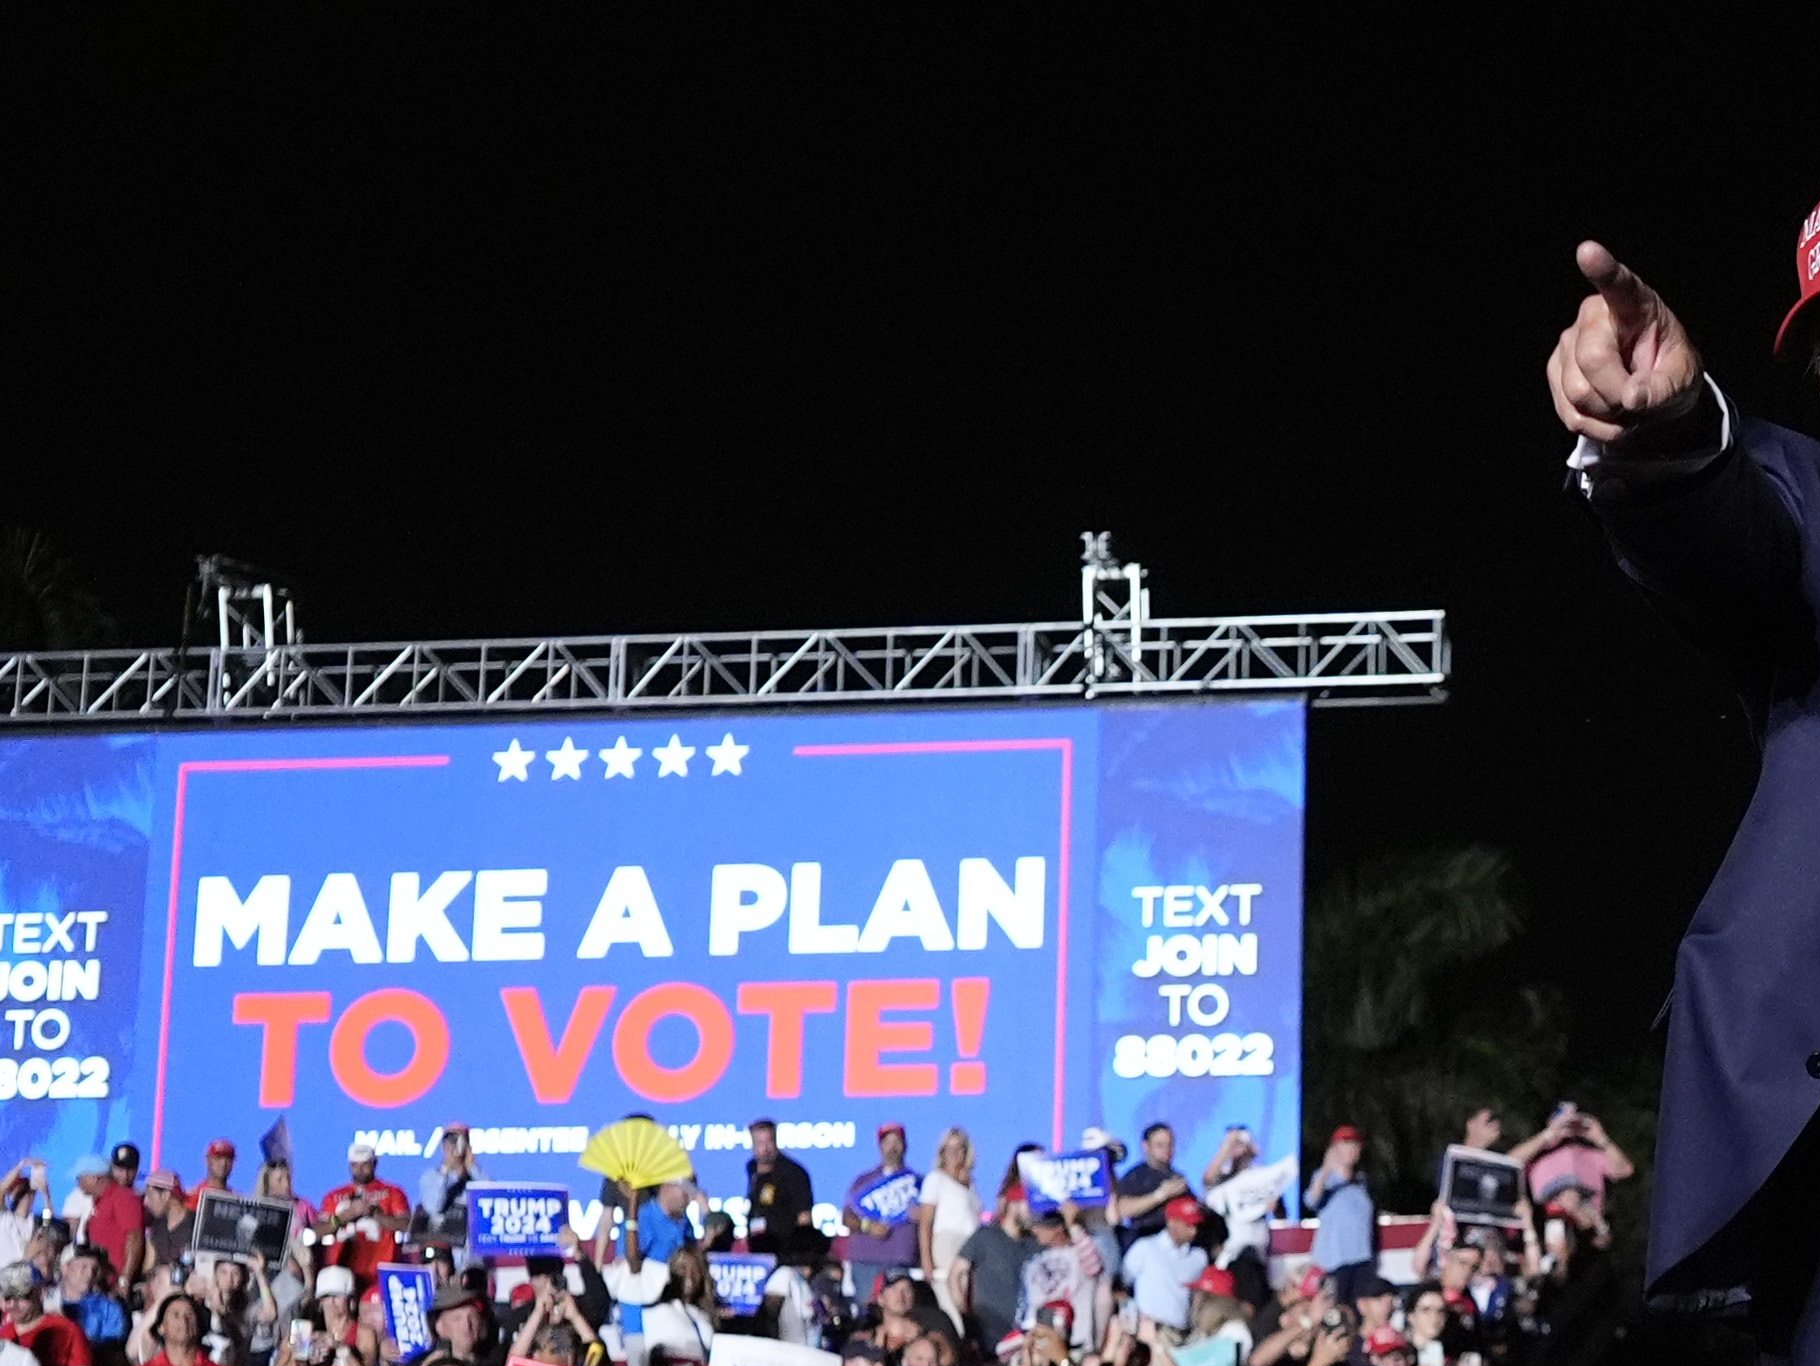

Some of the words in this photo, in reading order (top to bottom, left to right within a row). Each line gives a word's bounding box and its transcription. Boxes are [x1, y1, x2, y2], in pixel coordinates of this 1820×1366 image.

[193, 868, 548, 967] MAKE
[575, 866, 673, 959] A
[708, 856, 1046, 956] PLAN
[1131, 883, 1263, 928] TEXT
[1131, 933, 1258, 978] JOIN
[1158, 983, 1230, 1027] TO
[5, 1008, 70, 1050] TO
[232, 987, 450, 1108] TO
[500, 976, 990, 1104] VOTE!
[1112, 1032, 1274, 1079] 88022
[470, 1126, 589, 1154] BSENTEE
[478, 1197, 561, 1218] TRUMP
[490, 1214, 552, 1235] 2024
[709, 1264, 767, 1283] RUMP
